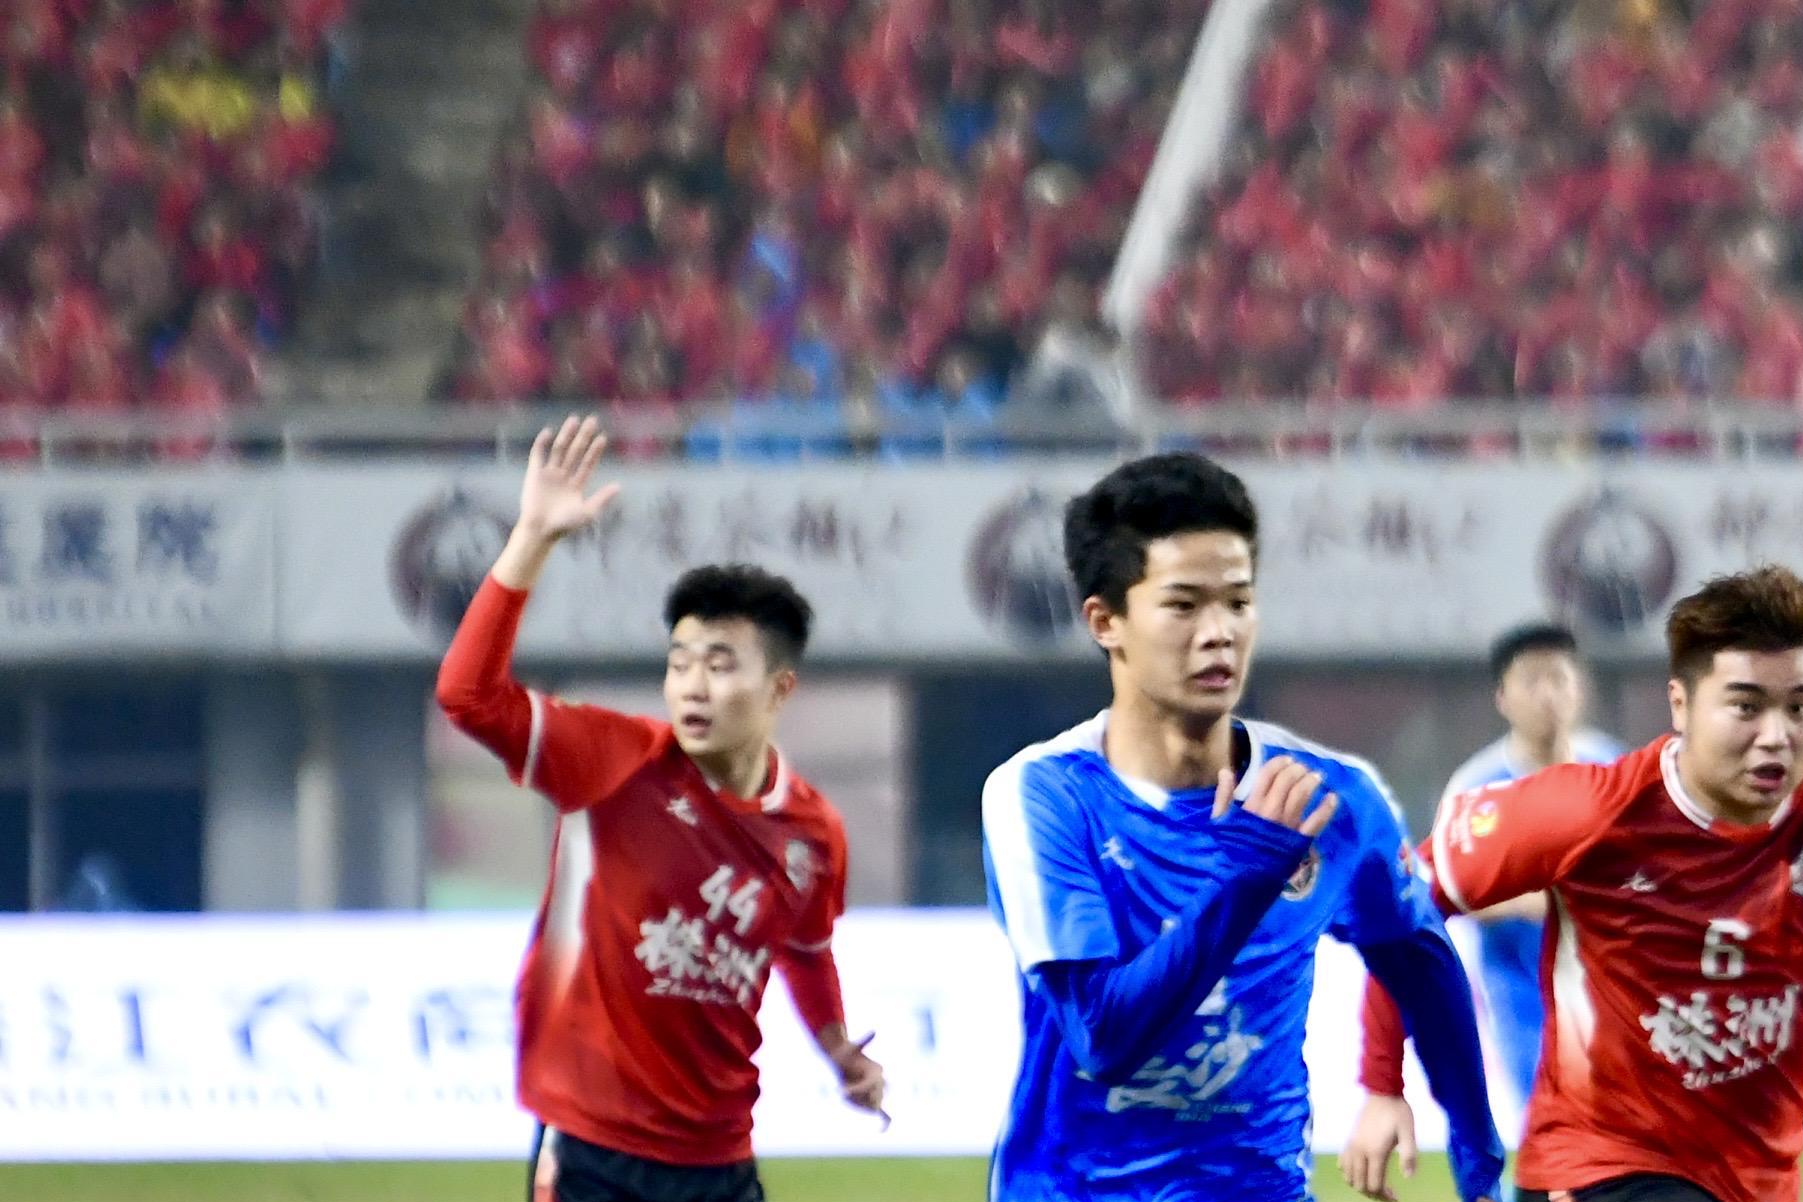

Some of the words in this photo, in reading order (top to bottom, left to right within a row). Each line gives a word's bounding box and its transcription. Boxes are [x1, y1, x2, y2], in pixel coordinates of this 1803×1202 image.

[699, 864, 763, 936] 44
[1701, 918, 1751, 980] 6
[1638, 984, 1802, 1066] 株洲
